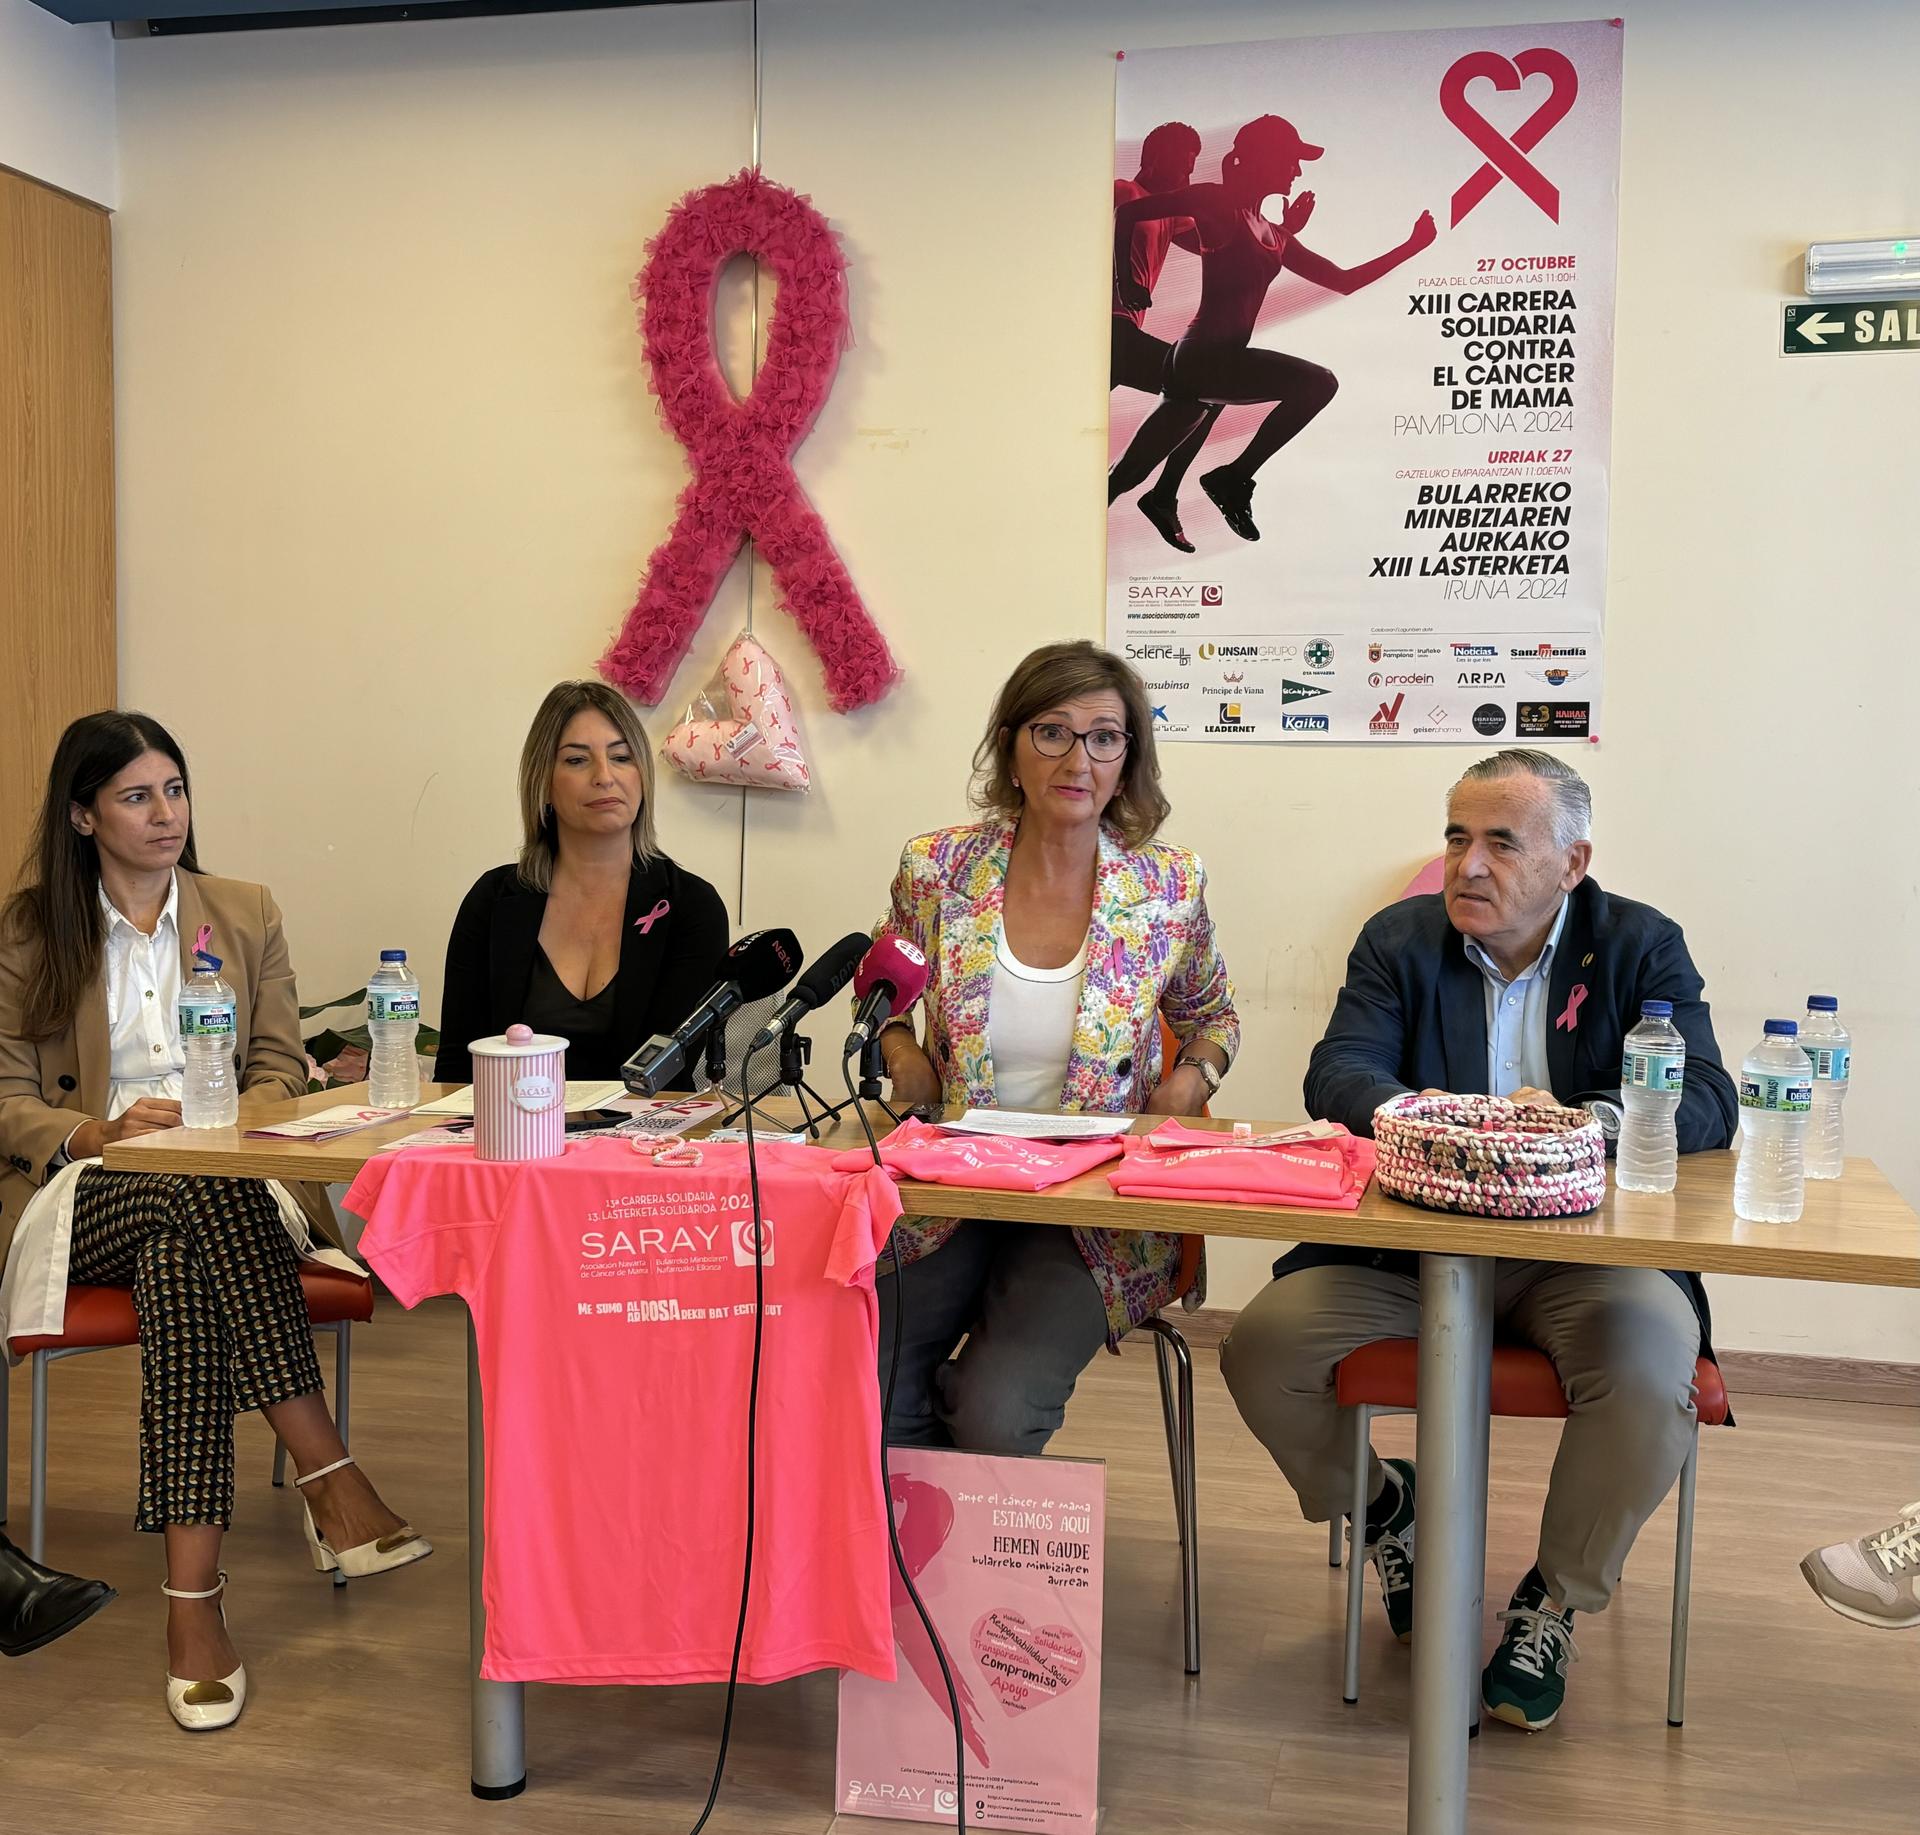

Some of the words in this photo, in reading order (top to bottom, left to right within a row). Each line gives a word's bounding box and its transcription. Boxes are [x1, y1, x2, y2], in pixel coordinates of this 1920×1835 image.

[1477, 258, 1496, 272] 27
[1501, 255, 1576, 271] OCTUBRE
[1418, 277, 1448, 287] PLAZA
[1450, 276, 1468, 286] DEL
[1469, 275, 1514, 286] CASTILLO
[1515, 274, 1524, 284] A
[1526, 273, 1543, 283] LAS
[1408, 294, 1451, 315] XIII
[1457, 290, 1577, 314] CARRERA
[1441, 314, 1576, 338] SOLIDARIA
[1463, 338, 1575, 361] CONTRA
[1433, 366, 1458, 386] EL
[1466, 360, 1575, 386] CÁNCER
[1451, 389, 1482, 410] DE
[1491, 387, 1574, 409] MAMA
[1394, 413, 1517, 436] PAMPLONA
[1524, 411, 1573, 432] 2024
[1488, 450, 1548, 464] URRIAK
[1553, 449, 1573, 463] 27
[1395, 469, 1450, 479] GAZTELUKO
[1452, 467, 1523, 478] EMPARANTZAN
[1417, 482, 1572, 505] BULARREKO
[1404, 506, 1572, 529] MINBIZIAREN
[1439, 530, 1570, 552] AURKAKO
[1368, 557, 1412, 577] XIII
[1419, 554, 1570, 576] LASTERKETA
[1128, 586, 1194, 599] SARAY
[1444, 576, 1510, 600] IRUÑA
[1517, 578, 1568, 599] 2024
[1125, 644, 1172, 659] Selene
[1456, 647, 1492, 656] Noticias
[1385, 673, 1434, 687] prodein
[1457, 672, 1506, 684] ARPA
[1234, 686, 1242, 694] de
[1285, 716, 1325, 729] Kaiku
[203, 1017, 230, 1026] DEHESA
[621, 1195, 665, 1206] CARRERA
[666, 1192, 716, 1204] SOLIDARIA
[602, 1207, 658, 1220] LASTERKETA
[659, 1204, 717, 1216] SOLIDARIOA
[581, 1225, 720, 1259] SARAY
[616, 1268, 627, 1276] de
[577, 1303, 593, 1315] ME
[596, 1303, 622, 1314] SUMO
[709, 1306, 729, 1319] BAT
[733, 1303, 763, 1316] EGIT
[958, 1492, 984, 1504] ante
[988, 1493, 998, 1504] el
[1003, 1494, 1037, 1508] cáncer
[1041, 1498, 1055, 1508] de
[1058, 1502, 1091, 1512] mama
[992, 1509, 1053, 1530] ESTAMOS
[993, 1536, 1039, 1556] HEMEN
[1046, 1540, 1090, 1560] GAUDE
[972, 1555, 1022, 1569] bularreko
[1026, 1561, 1089, 1574] minbiziaren
[1048, 1575, 1089, 1587] aurrean
[974, 1639, 1030, 1665] Transparencia
[1034, 1636, 1083, 1658] Solidaridad
[980, 1653, 1057, 1688] Compromiso
[991, 1676, 1029, 1702] Apoyo
[849, 1780, 926, 1801] SARAY
